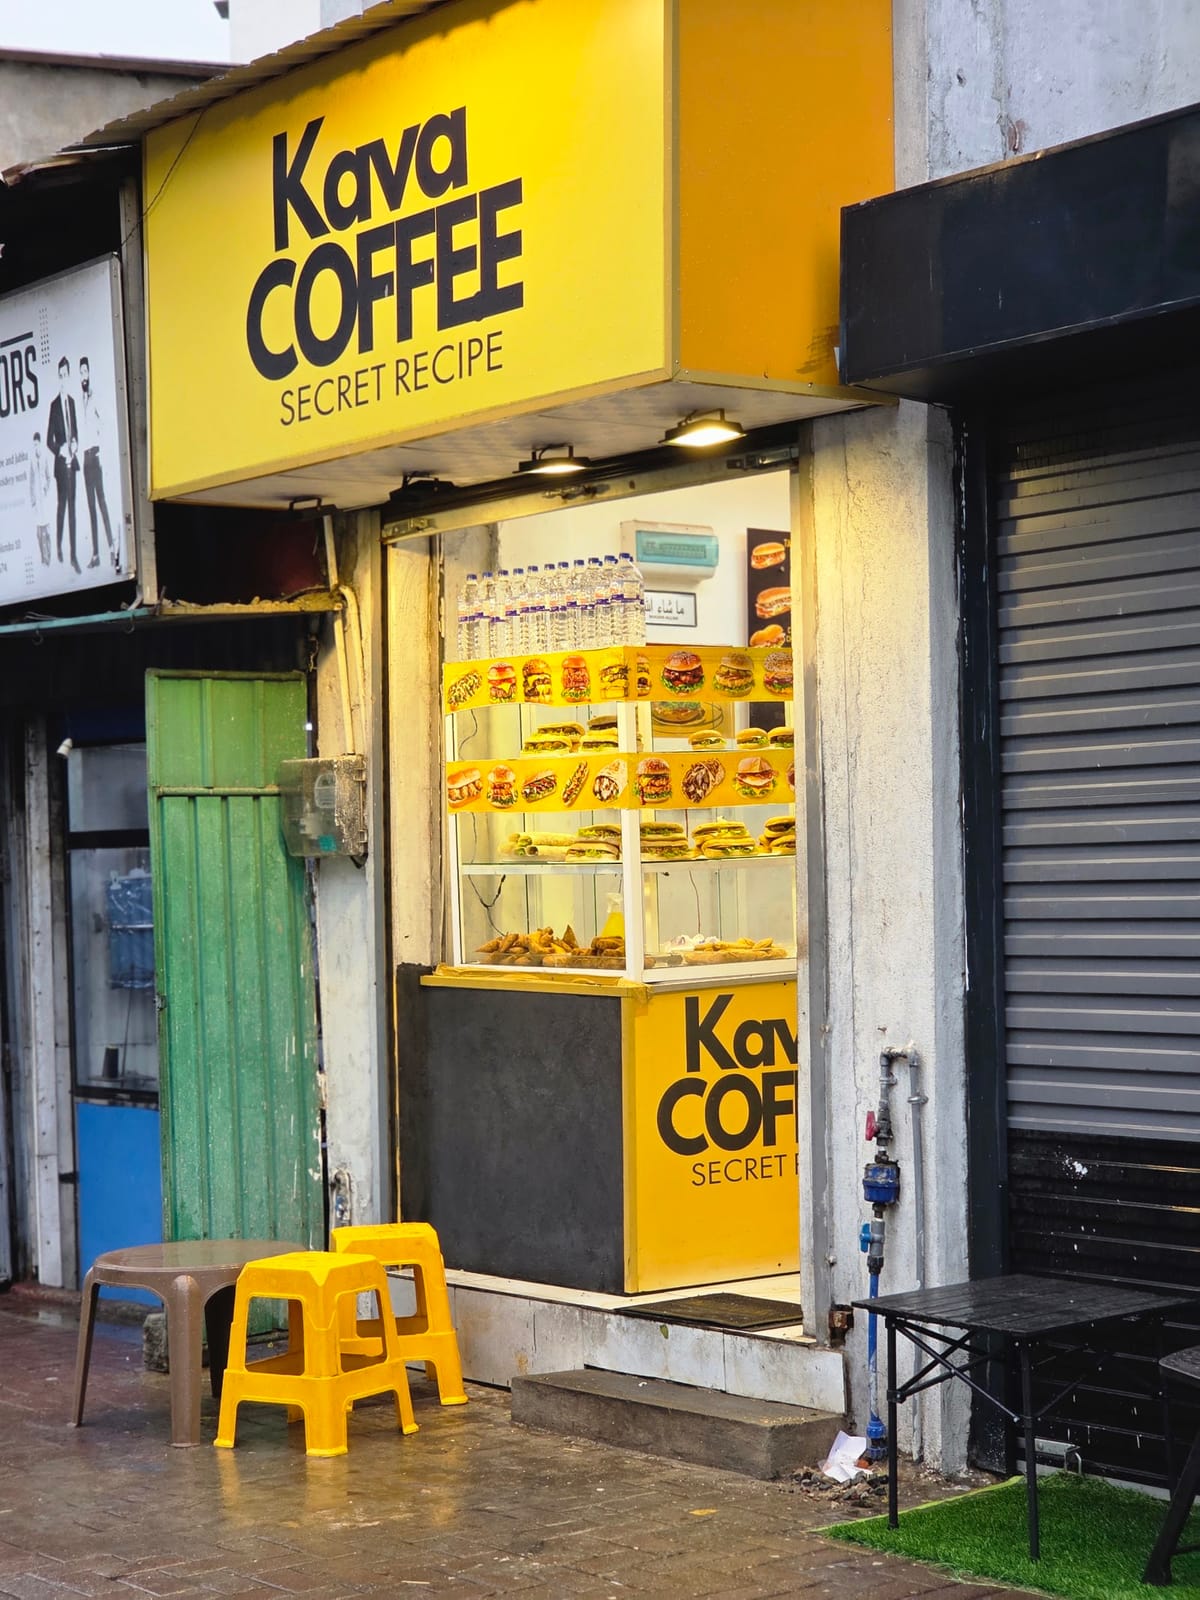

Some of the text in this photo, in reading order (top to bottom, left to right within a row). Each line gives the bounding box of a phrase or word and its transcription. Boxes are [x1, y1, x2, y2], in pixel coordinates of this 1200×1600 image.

[272, 105, 469, 252] Kava
[246, 177, 524, 381] COFFEE
[280, 330, 503, 426] SECRET RECIPE
[656, 1070, 799, 1156] COF
[691, 1154, 788, 1186] SECRET
